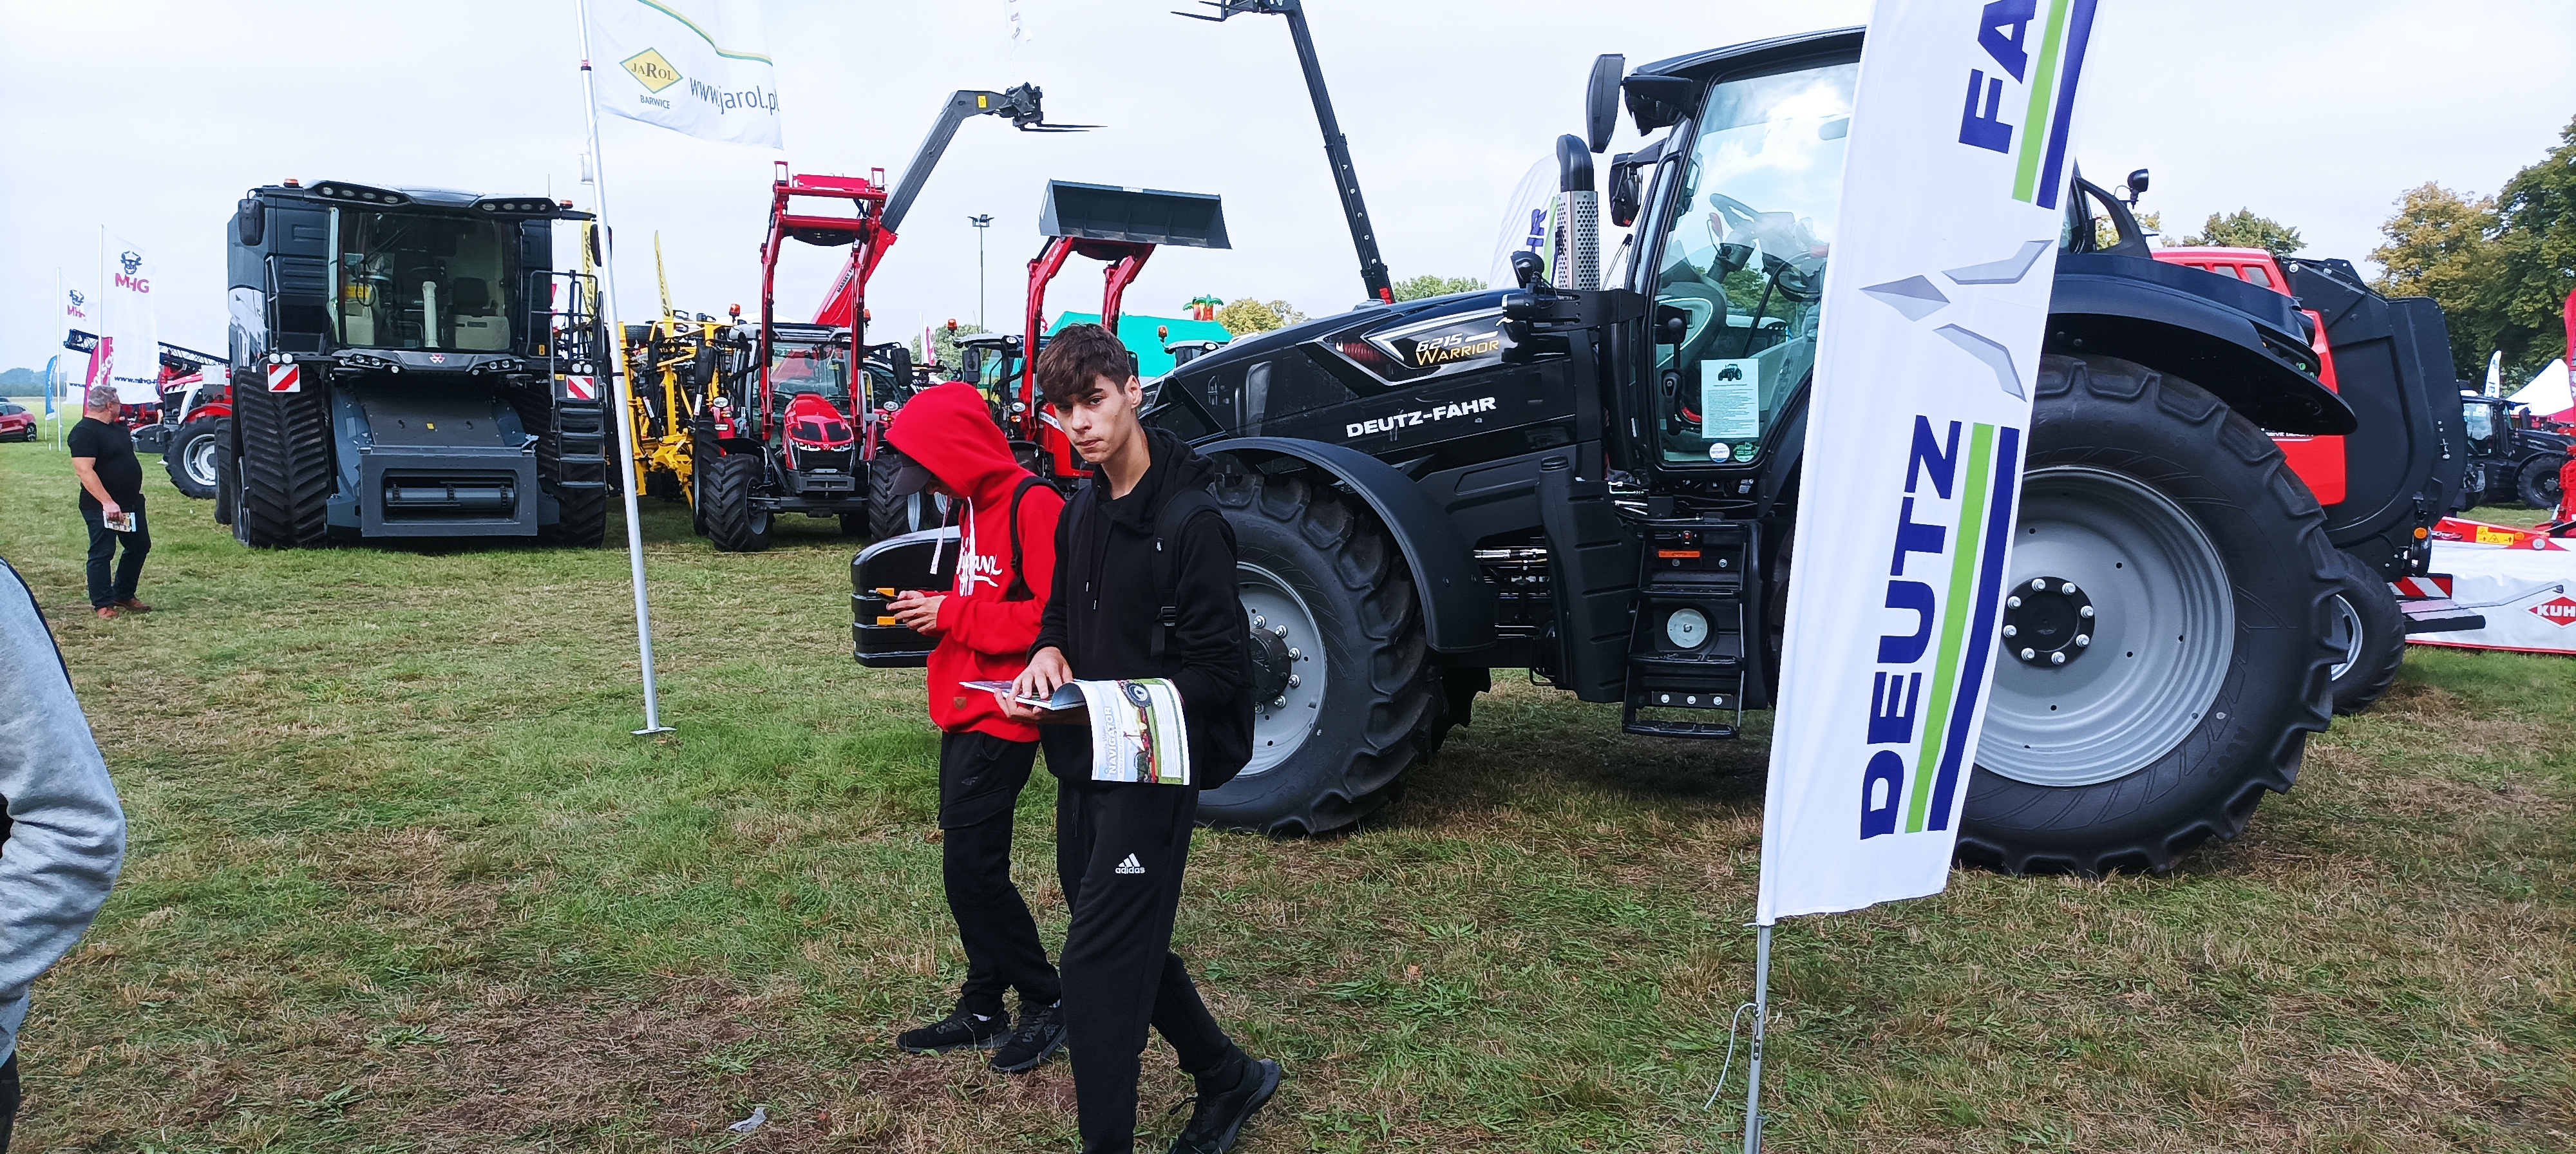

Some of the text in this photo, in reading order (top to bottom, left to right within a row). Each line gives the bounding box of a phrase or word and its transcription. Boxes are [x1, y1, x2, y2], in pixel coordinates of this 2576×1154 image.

[640, 95, 670, 109] BARWICE
[689, 77, 780, 116] www.jarol.pl
[115, 272, 149, 294] MHG
[1416, 333, 1463, 352] 6215
[1416, 339, 1500, 366] WARRIOR
[1346, 397, 1497, 438] DEUTZ-FAHR
[1860, 415, 1962, 840] DEUTZ
[1103, 706, 1117, 775] NAVIGATOR
